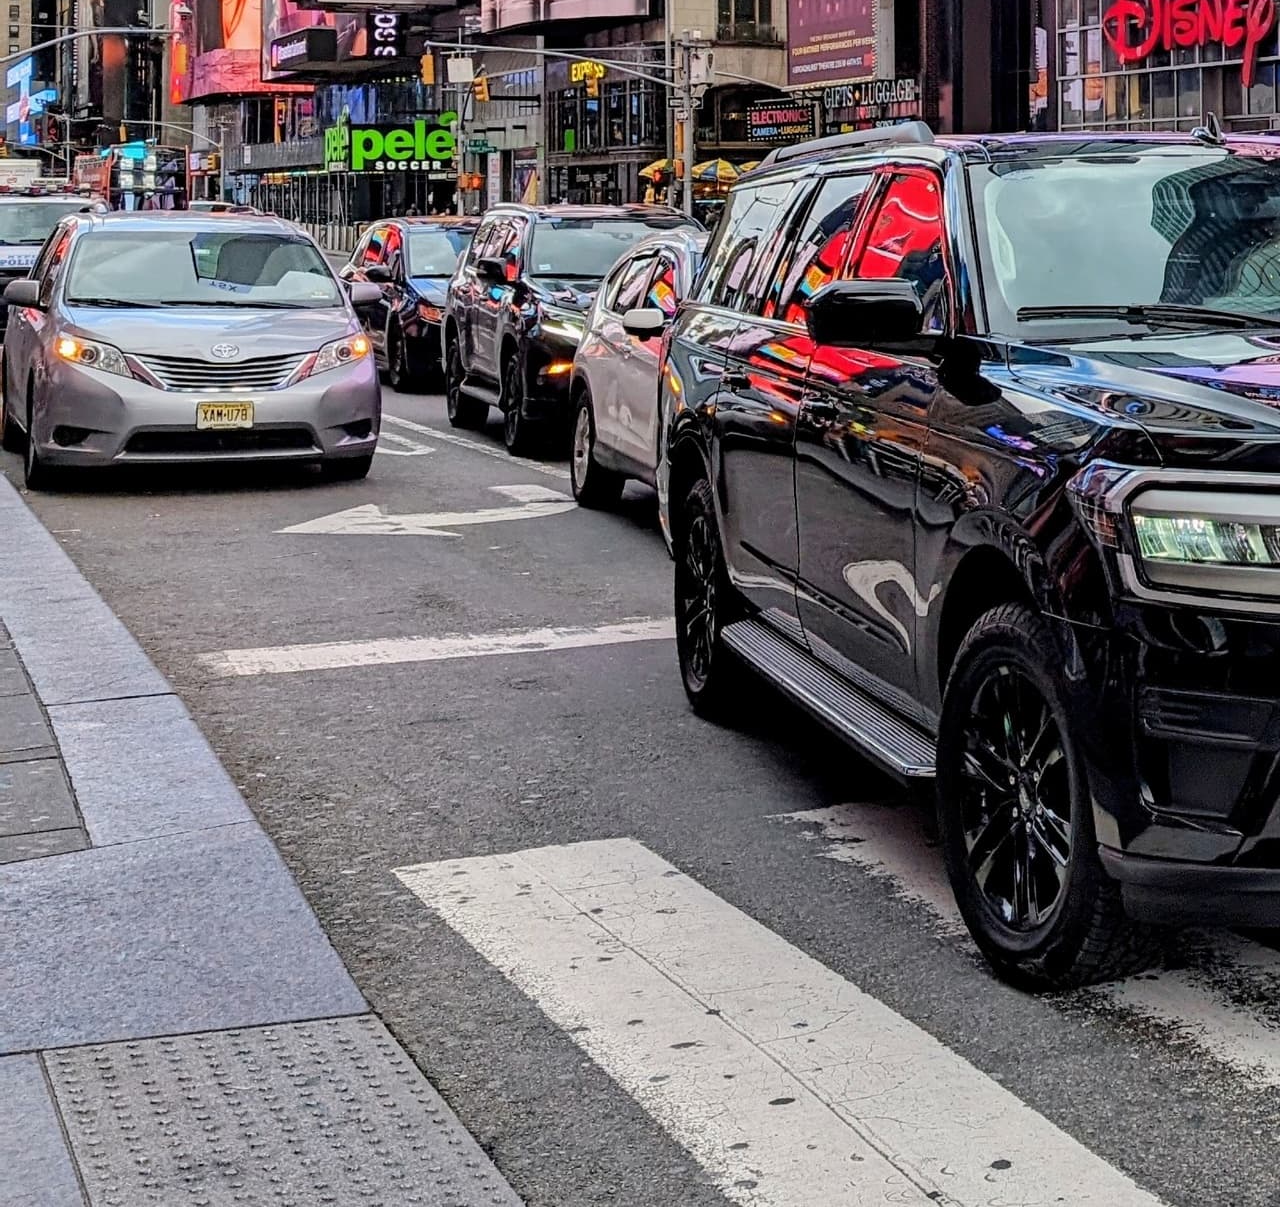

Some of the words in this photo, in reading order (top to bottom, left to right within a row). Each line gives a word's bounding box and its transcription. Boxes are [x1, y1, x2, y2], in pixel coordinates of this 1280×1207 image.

[824, 85, 853, 109] GIFTS
[861, 79, 915, 106] LUGGAGE
[751, 109, 809, 125] ELECTRONICS
[752, 126, 778, 136] CAMERA
[780, 125, 809, 135] LUGGAGE
[375, 160, 442, 171] SOCCER
